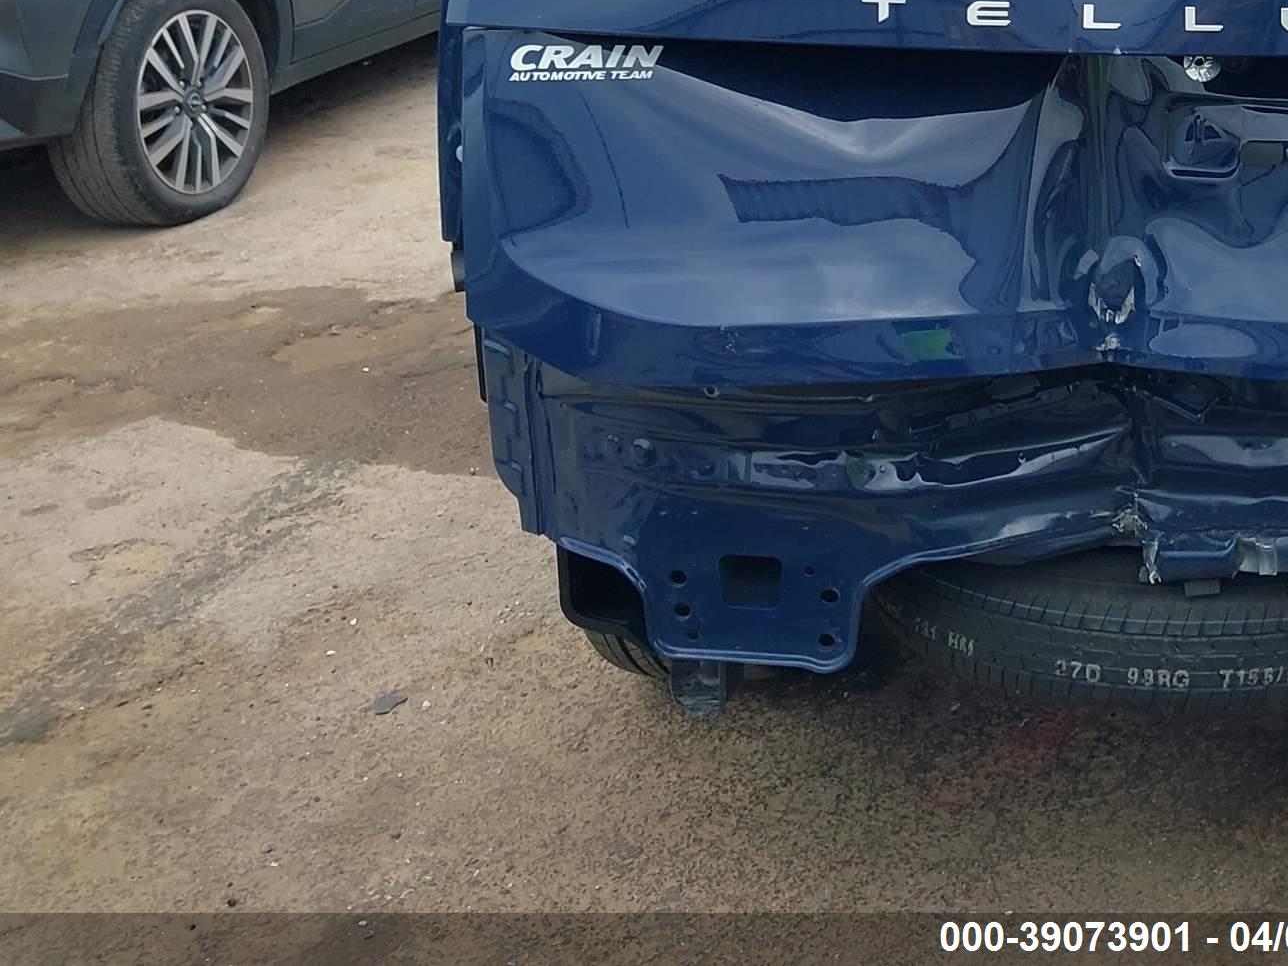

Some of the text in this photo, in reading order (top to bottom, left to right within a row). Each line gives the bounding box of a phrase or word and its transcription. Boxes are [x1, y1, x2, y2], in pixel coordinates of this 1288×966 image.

[510, 44, 664, 71] CRAIN
[509, 70, 654, 82] AUTOMOTIVE TEAM
